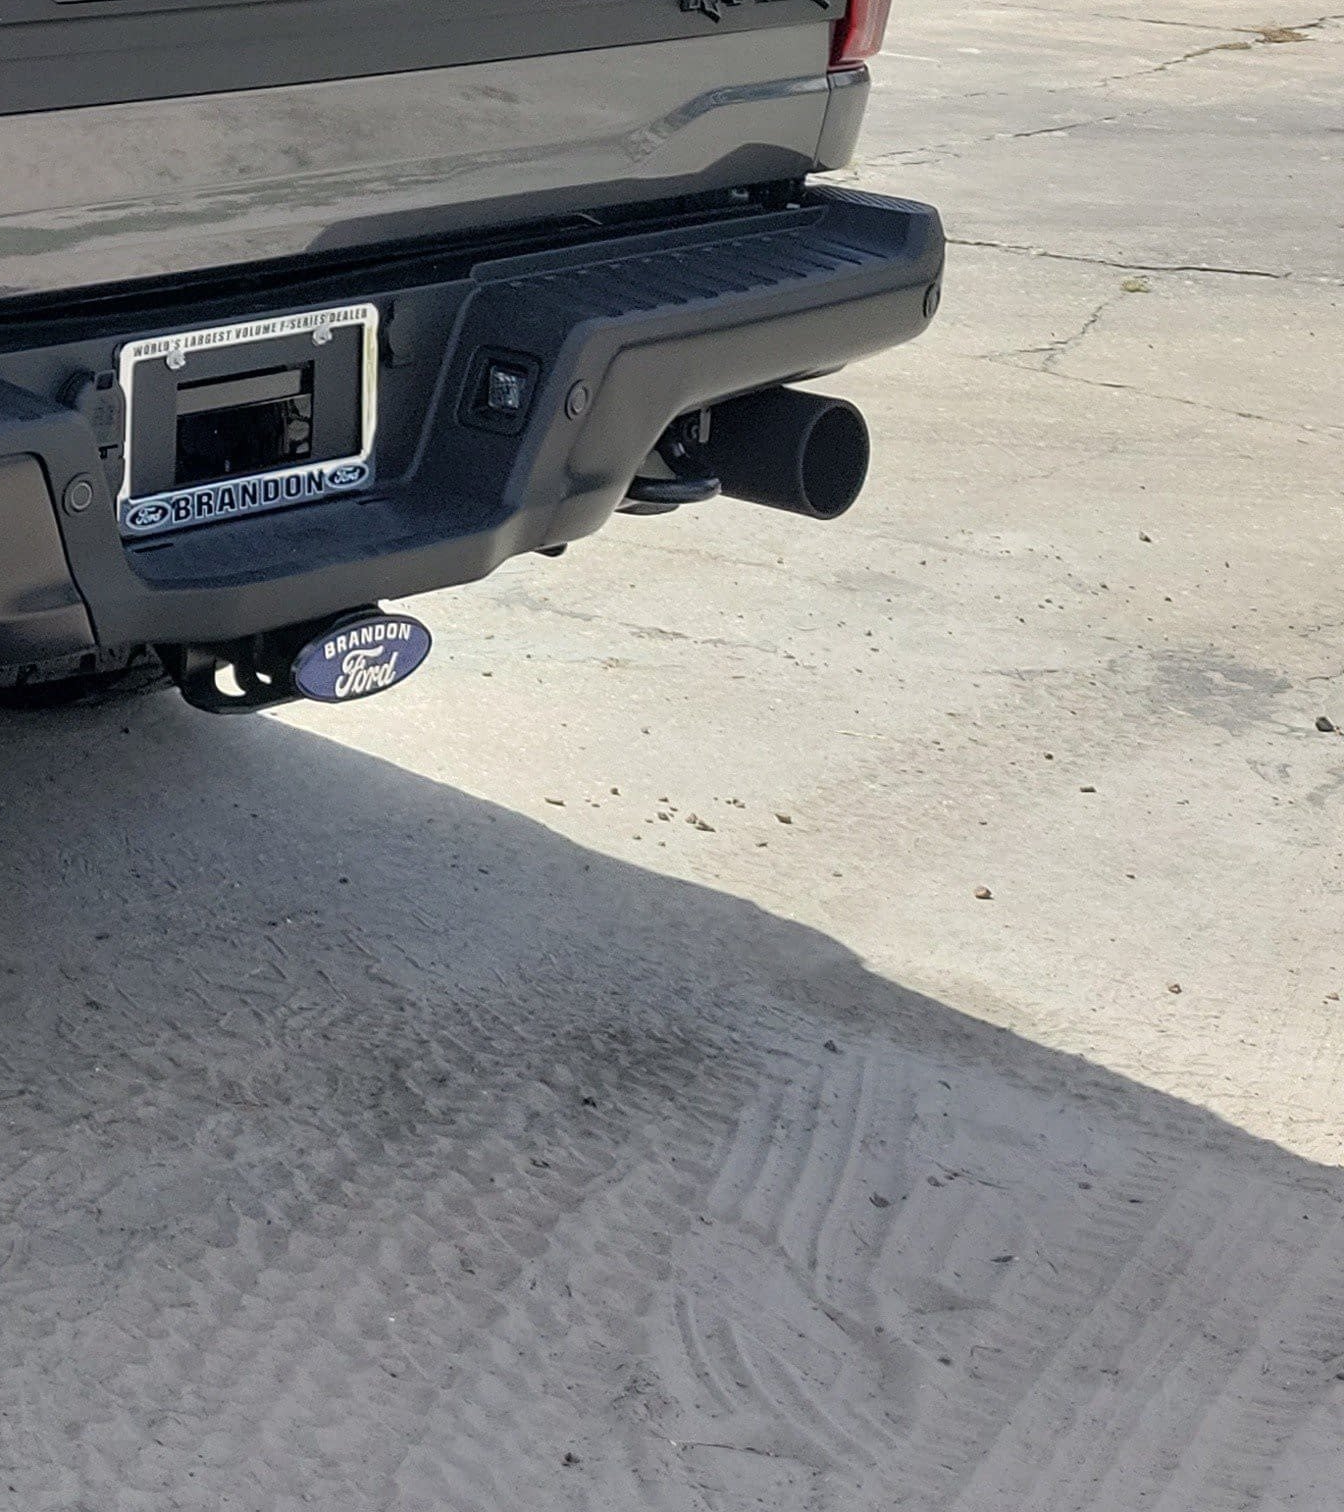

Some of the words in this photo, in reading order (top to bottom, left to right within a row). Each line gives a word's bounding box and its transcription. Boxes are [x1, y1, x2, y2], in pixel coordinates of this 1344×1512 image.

[133, 338, 181, 357] WORLD'S
[184, 329, 232, 348] LARGEST
[235, 322, 276, 339] VOLUME
[280, 314, 326, 332] F-SERIES
[134, 505, 164, 526] Ford
[173, 468, 325, 522] BRANDON
[333, 465, 360, 484] Ford
[323, 622, 412, 659] BRANDON
[334, 645, 399, 698] Ford
